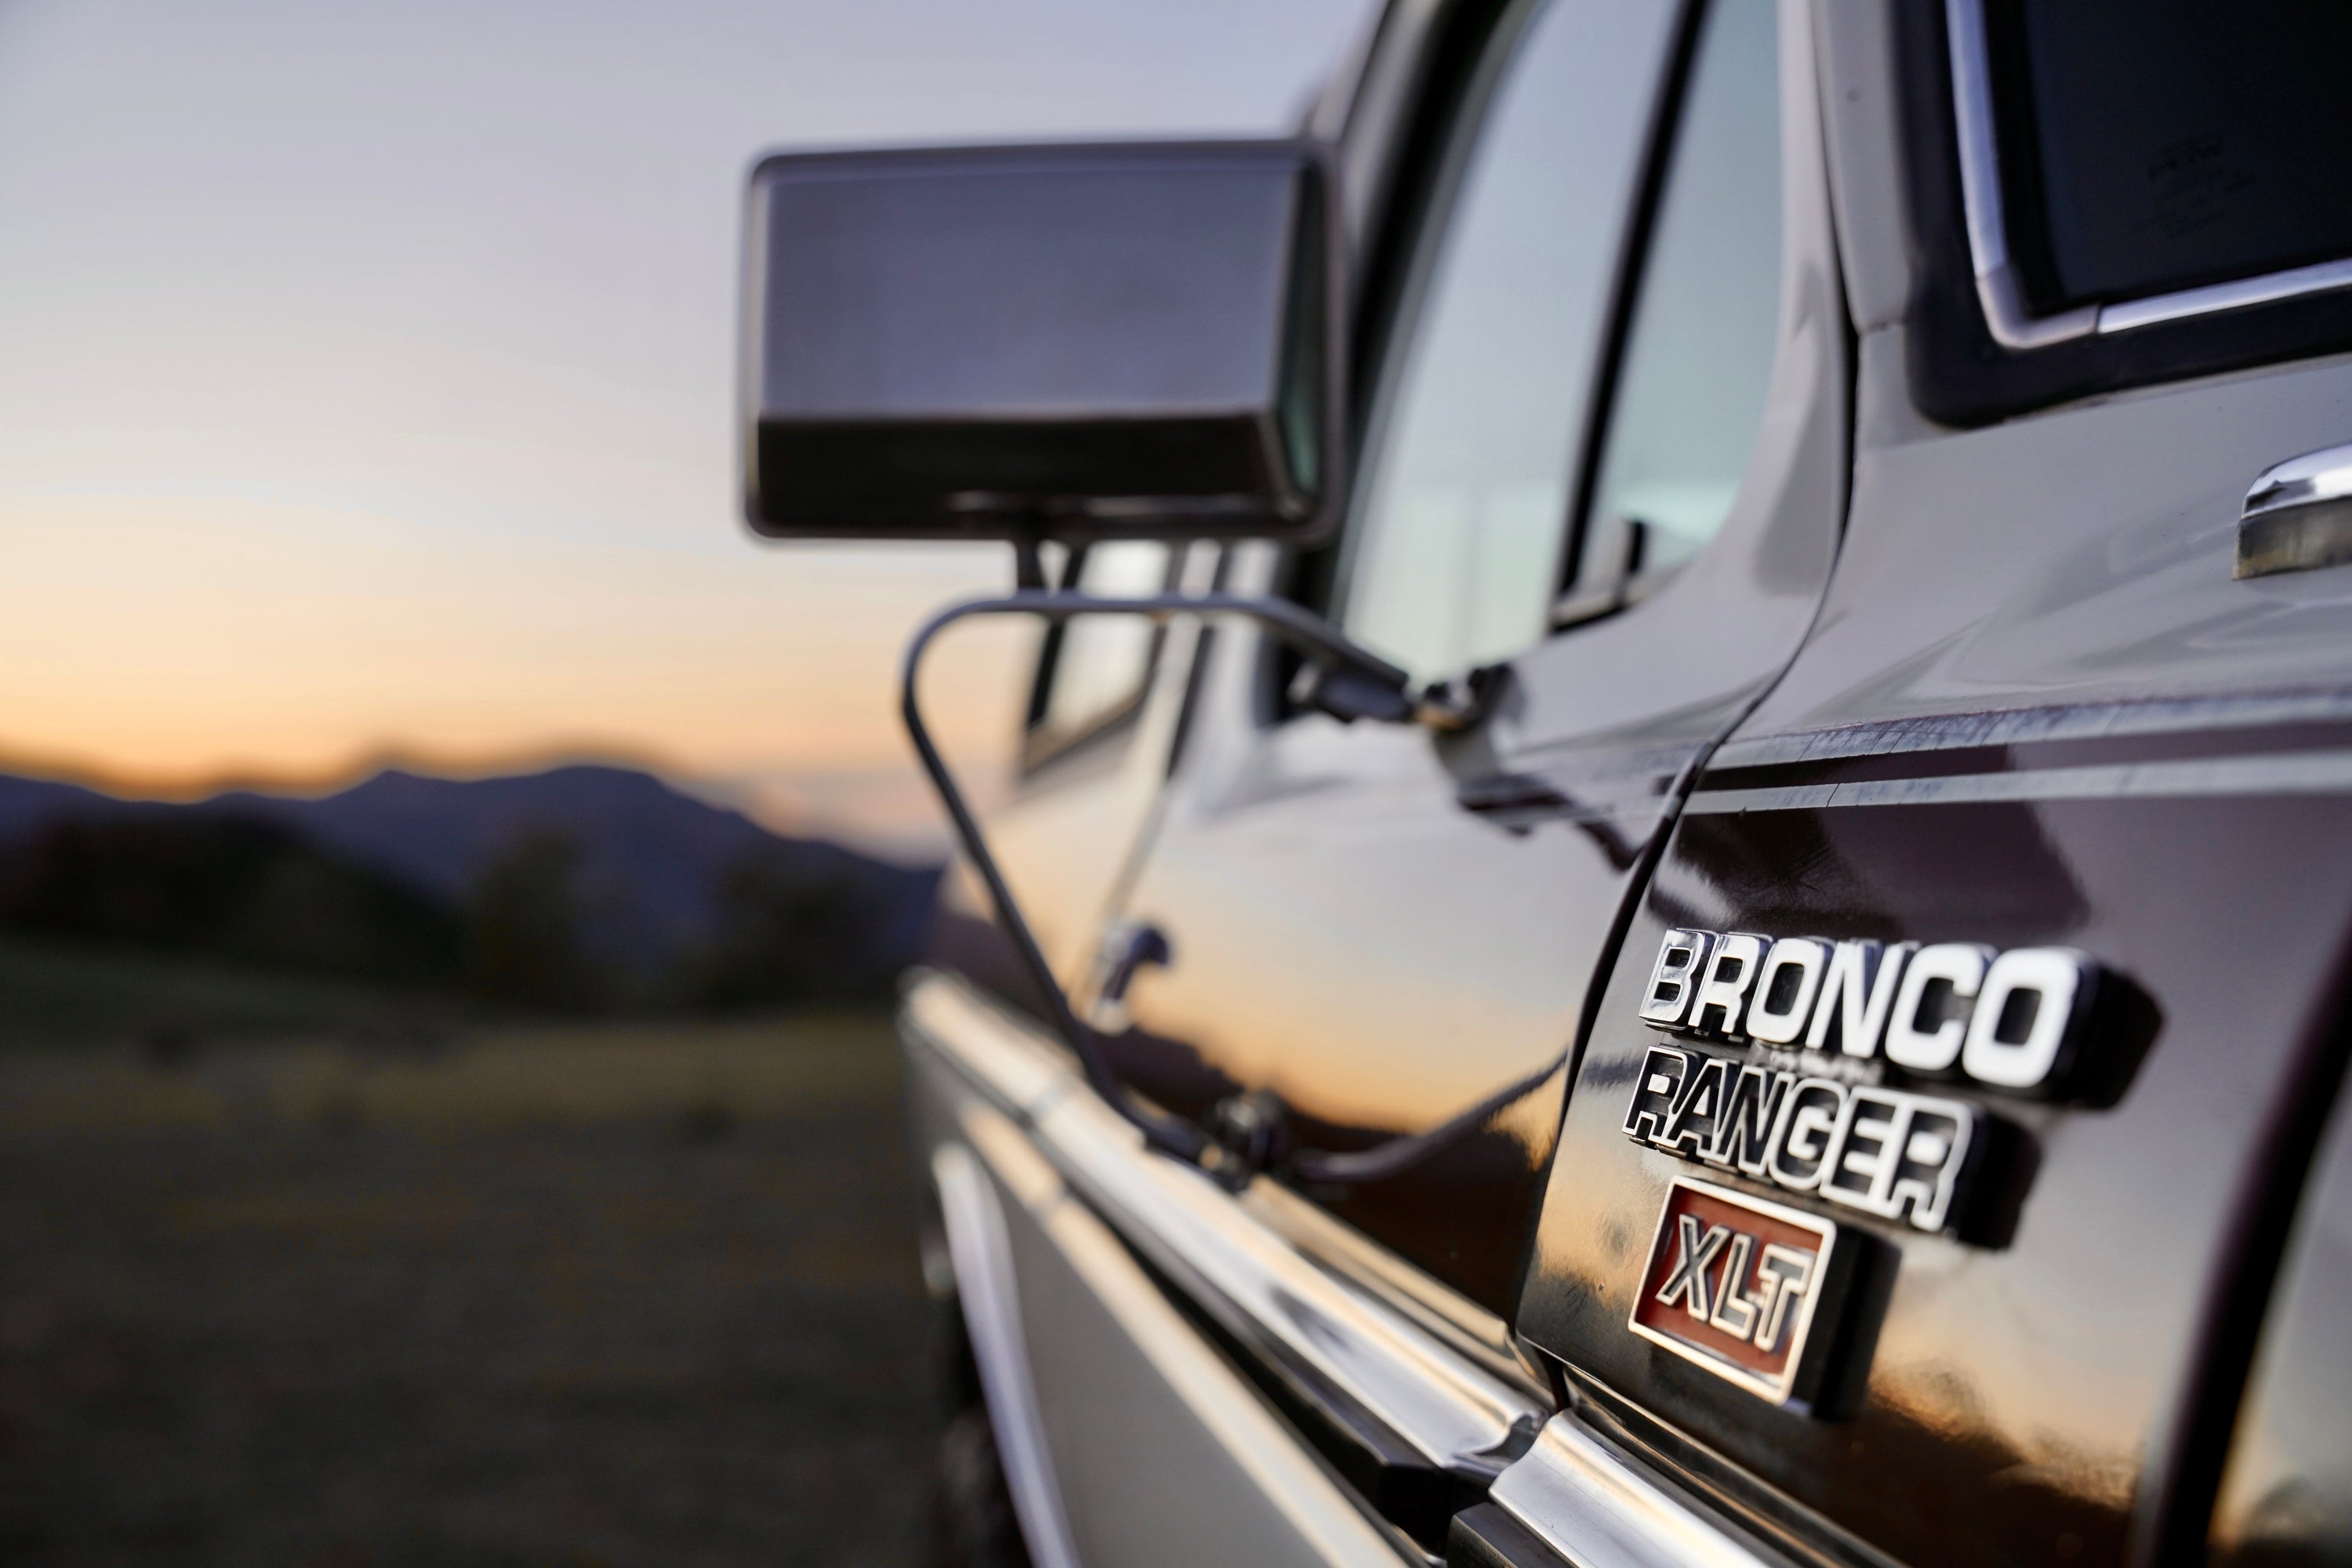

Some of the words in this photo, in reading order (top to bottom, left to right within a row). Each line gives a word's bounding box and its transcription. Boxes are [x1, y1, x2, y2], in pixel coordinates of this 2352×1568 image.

[1638, 928, 2085, 1088] BRONCO
[1621, 1044, 1976, 1232] RANGER
[1655, 1214, 1816, 1354] XLT
